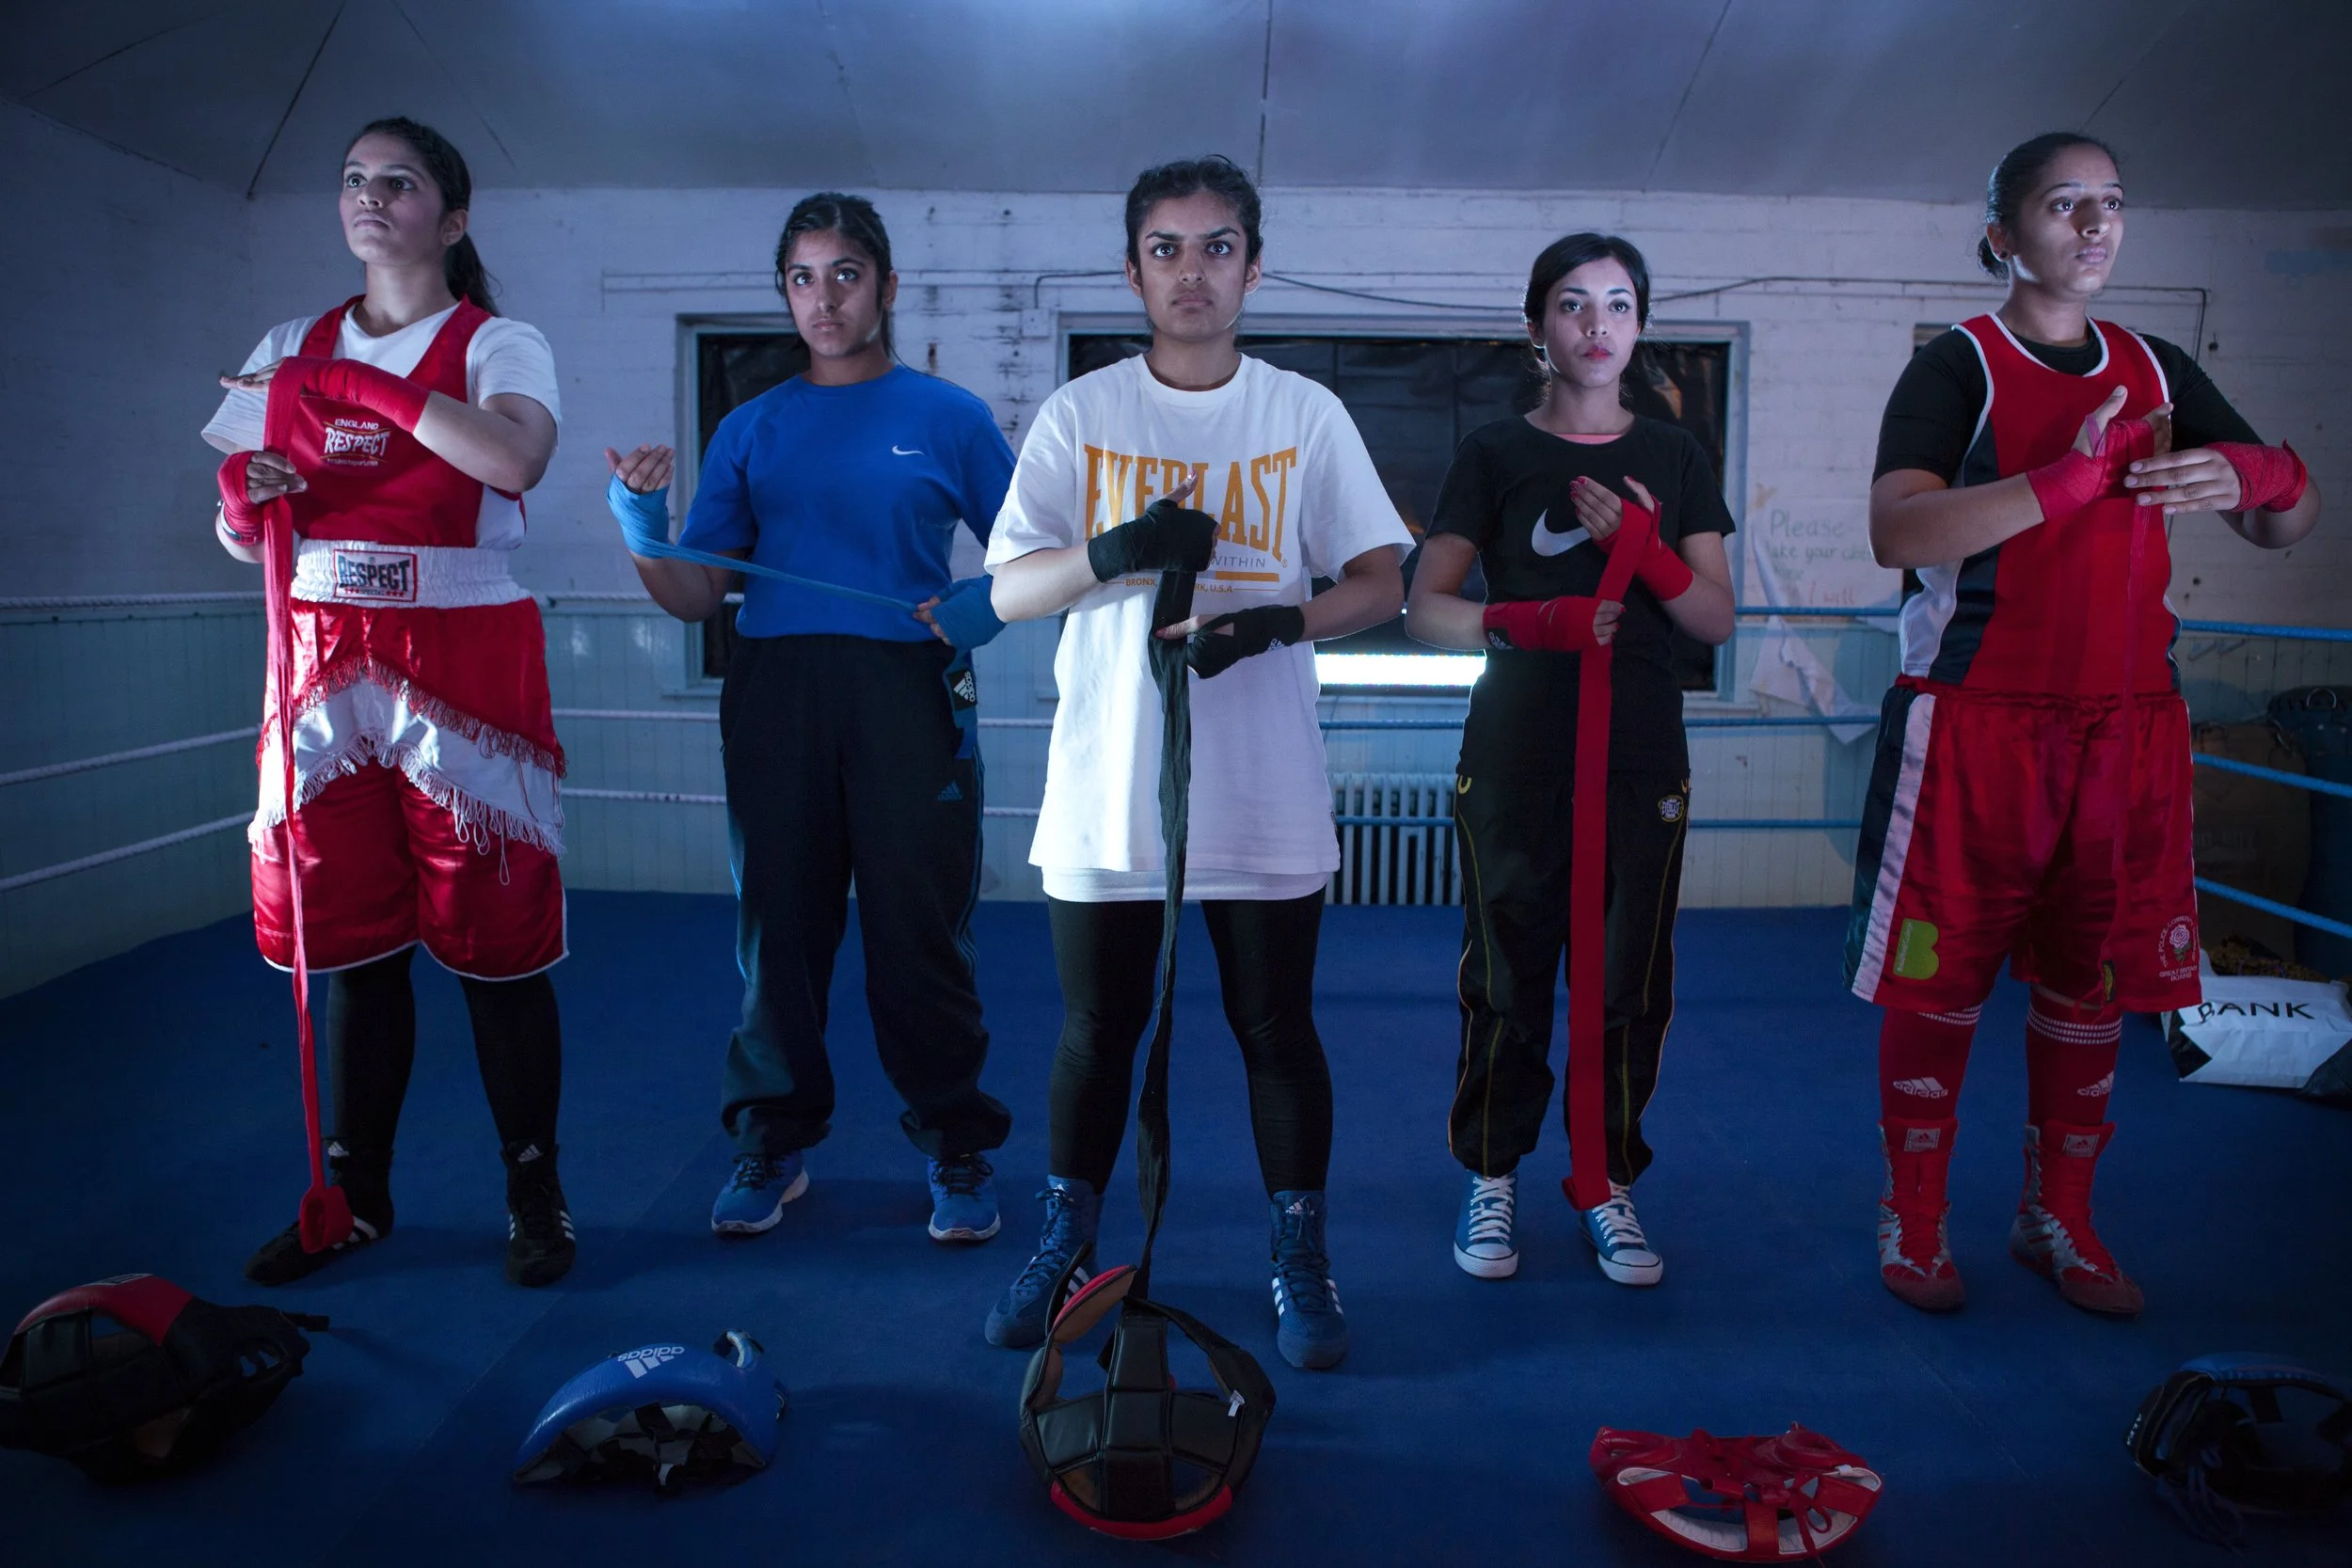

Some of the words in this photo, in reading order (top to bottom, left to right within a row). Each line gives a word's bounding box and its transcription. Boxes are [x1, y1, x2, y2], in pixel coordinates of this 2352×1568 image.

[335, 418, 379, 430] ENGLAND
[325, 426, 390, 457] RESPECT
[1770, 508, 1845, 538] Please
[1209, 556, 1265, 568] WITHIN
[1804, 546, 1838, 565] your
[337, 555, 410, 592] RESPECT
[1125, 578, 1158, 588] BRONX,
[2198, 1001, 2315, 1023] BANK
[1893, 1080, 1949, 1100] adidas
[616, 1346, 685, 1362] adidas
